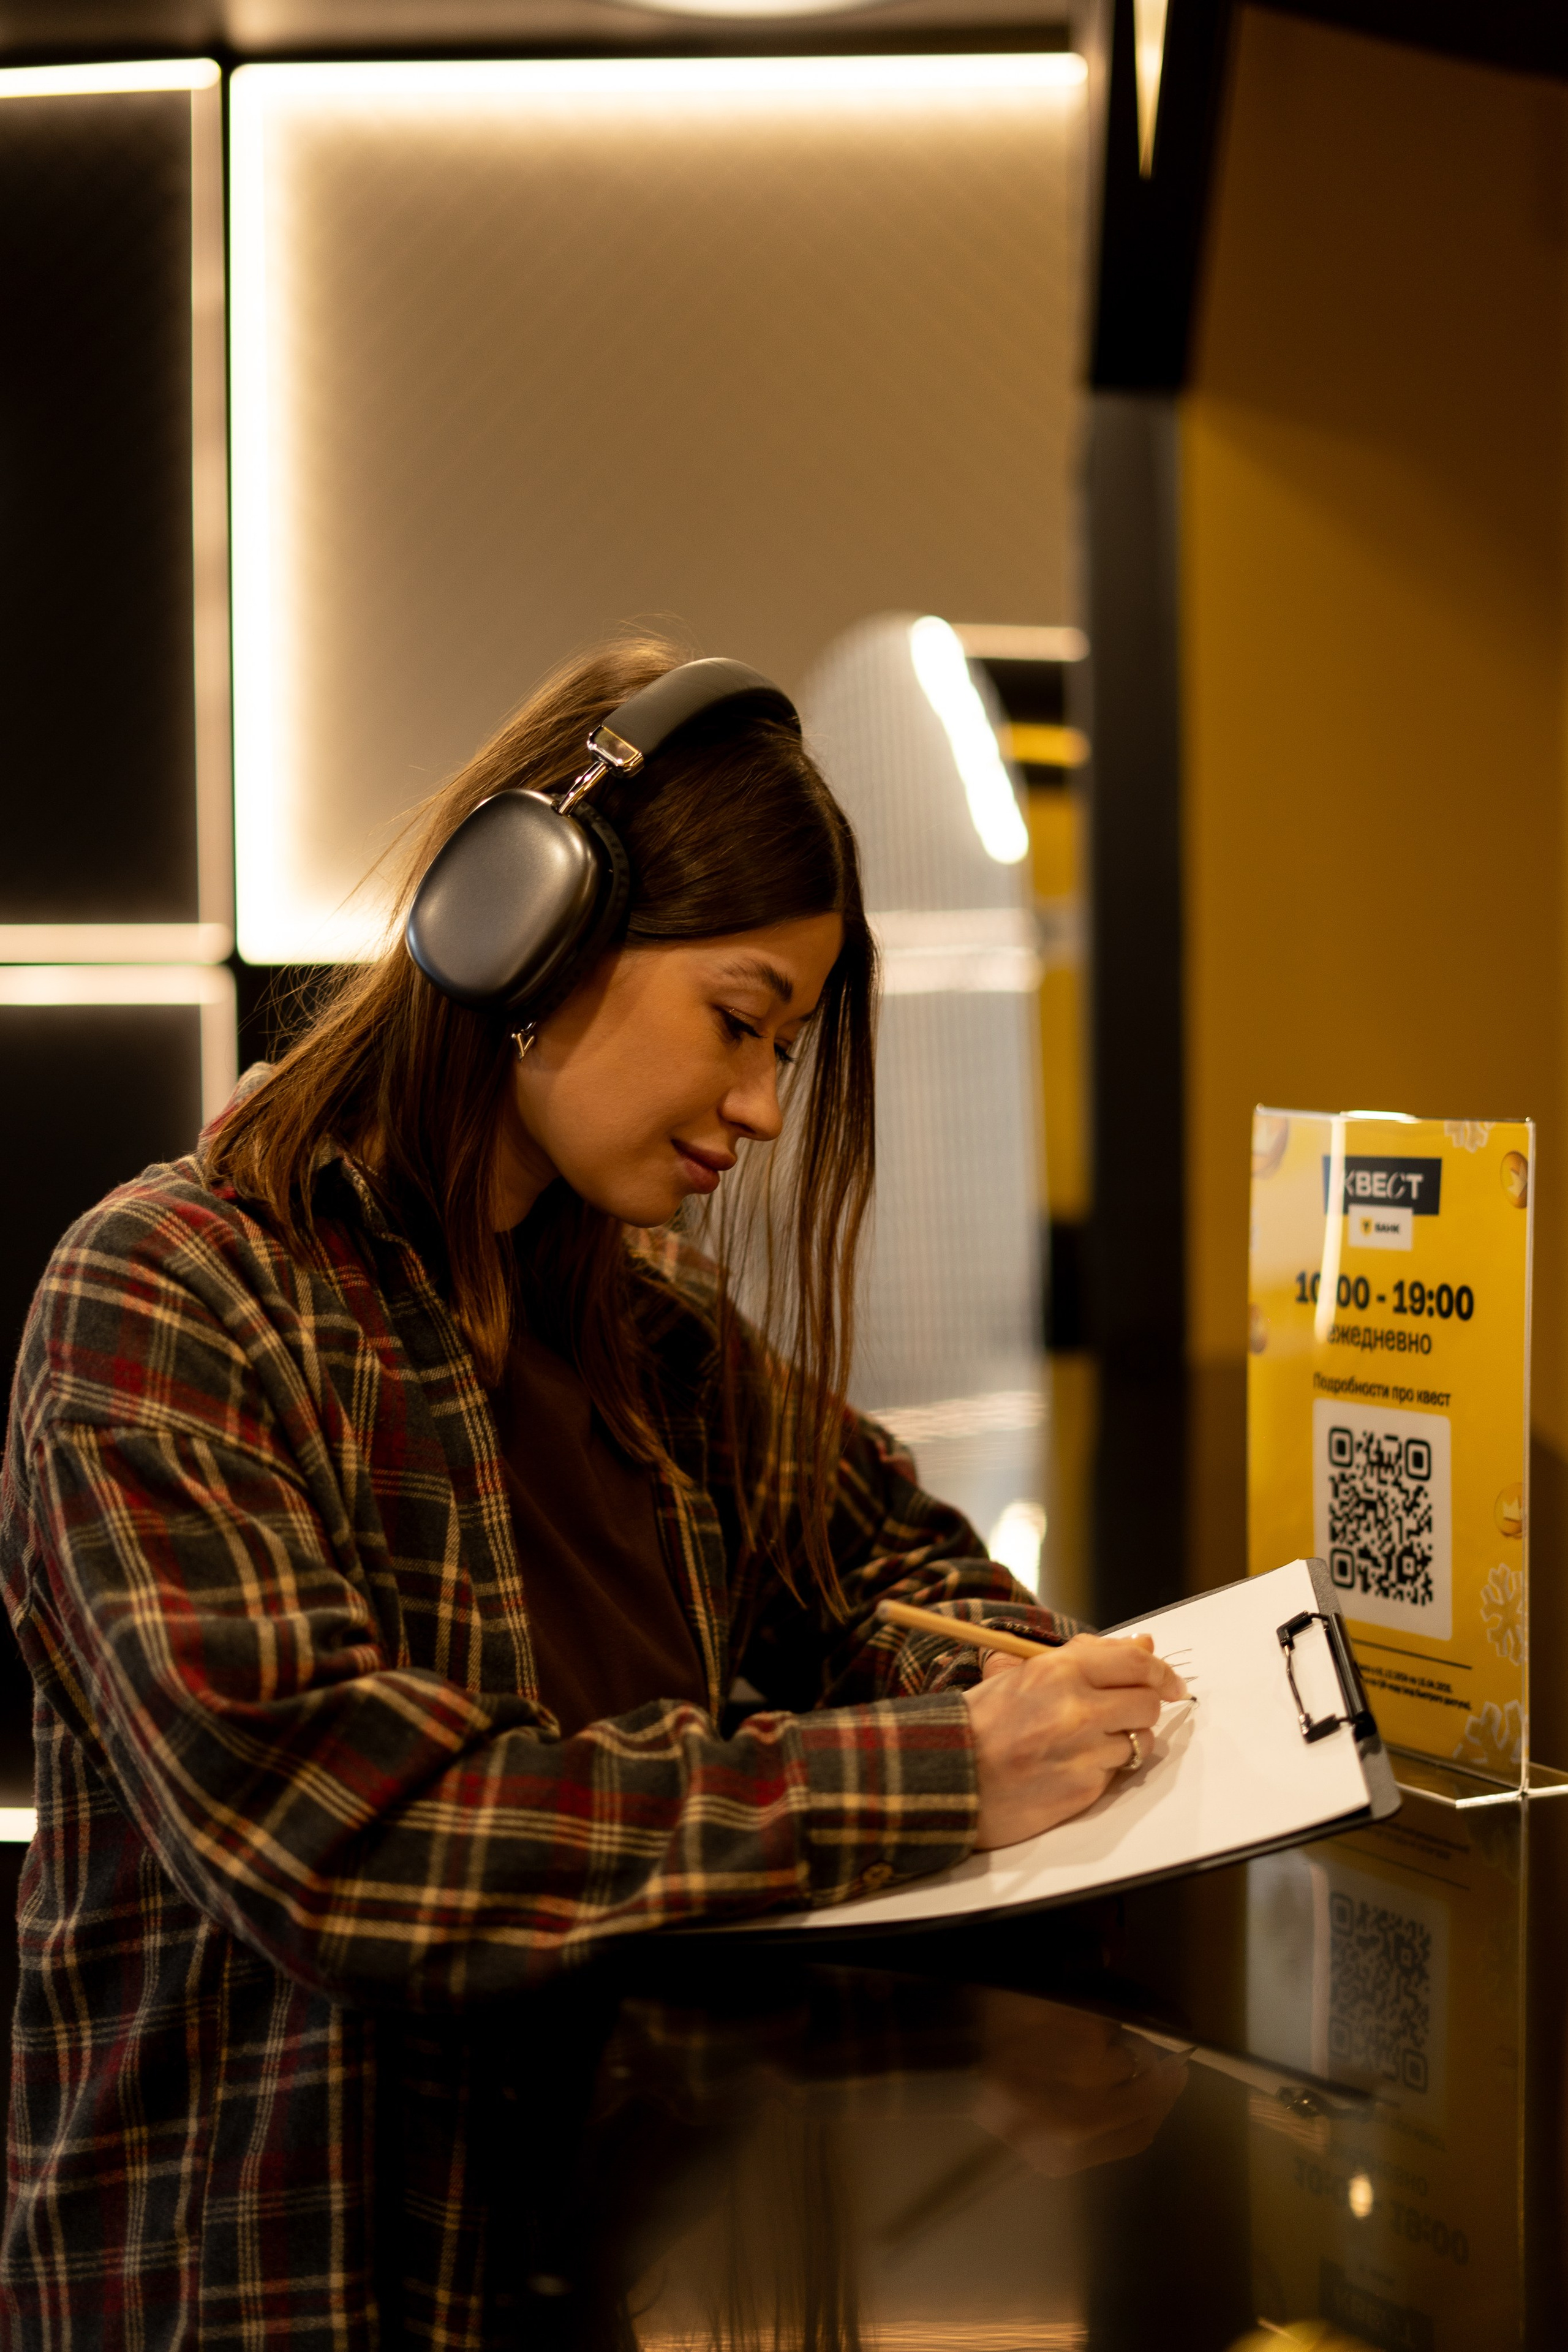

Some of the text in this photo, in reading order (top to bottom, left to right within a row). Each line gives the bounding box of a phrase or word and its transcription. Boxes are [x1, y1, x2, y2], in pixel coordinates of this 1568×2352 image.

[1374, 1221, 1400, 1234] БАНК
[1392, 1279, 1474, 1321] 19:00
[1327, 1323, 1432, 1355] ежедневно
[1313, 1371, 1451, 1407] Подробности про квест
